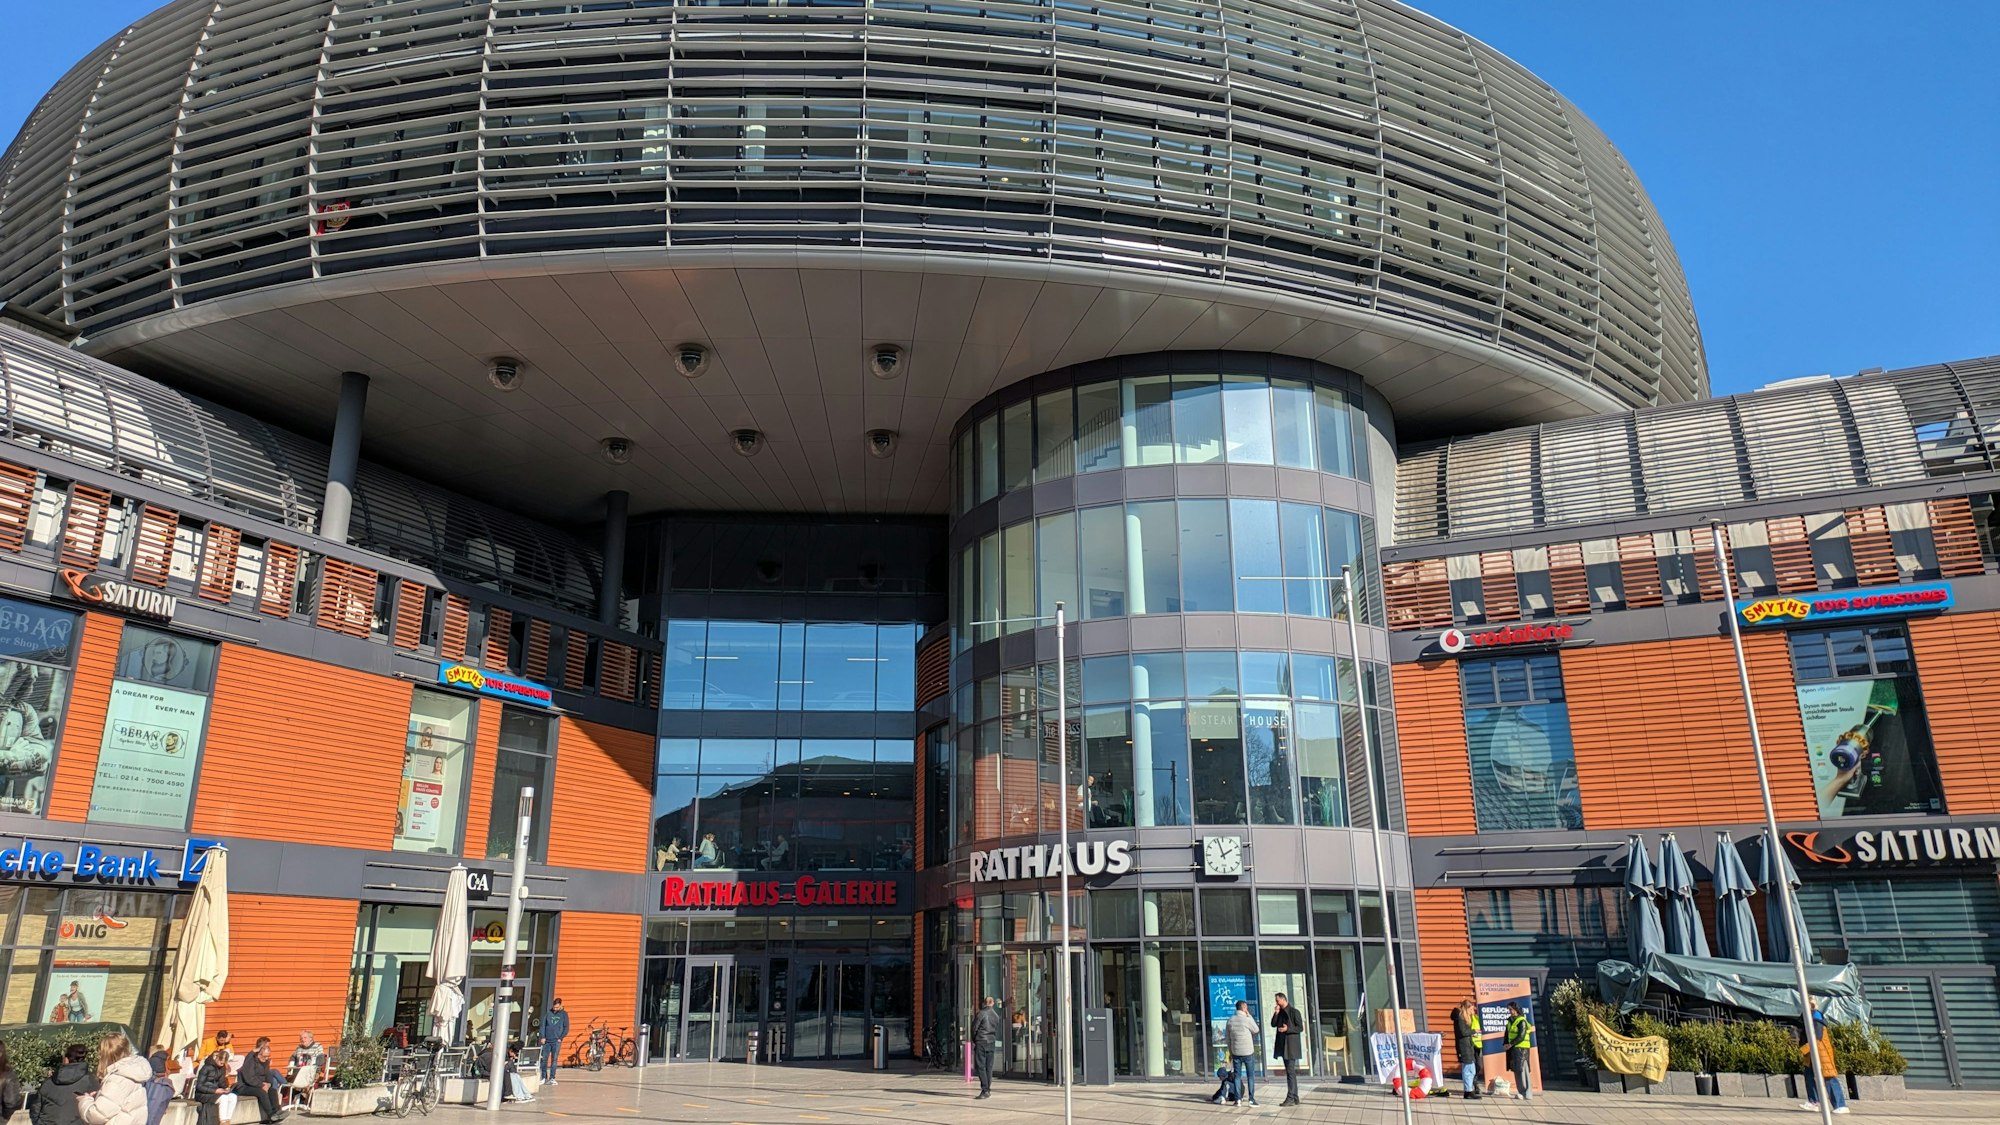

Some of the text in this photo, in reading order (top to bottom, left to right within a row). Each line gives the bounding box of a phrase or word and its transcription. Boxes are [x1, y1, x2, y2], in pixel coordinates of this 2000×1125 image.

[103, 581, 177, 617] SATURN
[1744, 589, 1948, 621] SMYTHS TOYS SUPERSTORES
[13, 636, 39, 651] Shop
[1470, 624, 1573, 646] vodafone
[446, 666, 485, 687] SMYTHS
[122, 689, 148, 699] DREAM
[150, 694, 164, 702] FOR
[155, 705, 178, 713] EVERY
[1200, 711, 1234, 726] STEAK
[1250, 712, 1286, 727] HOUSE
[120, 774, 139, 782] 0214
[146, 777, 165, 785] 7500
[166, 780, 185, 788] 4590
[1855, 827, 2000, 862] SATURN
[74, 845, 161, 880] Bank
[970, 840, 1132, 882] RATHAUS
[467, 873, 489, 891] C&A
